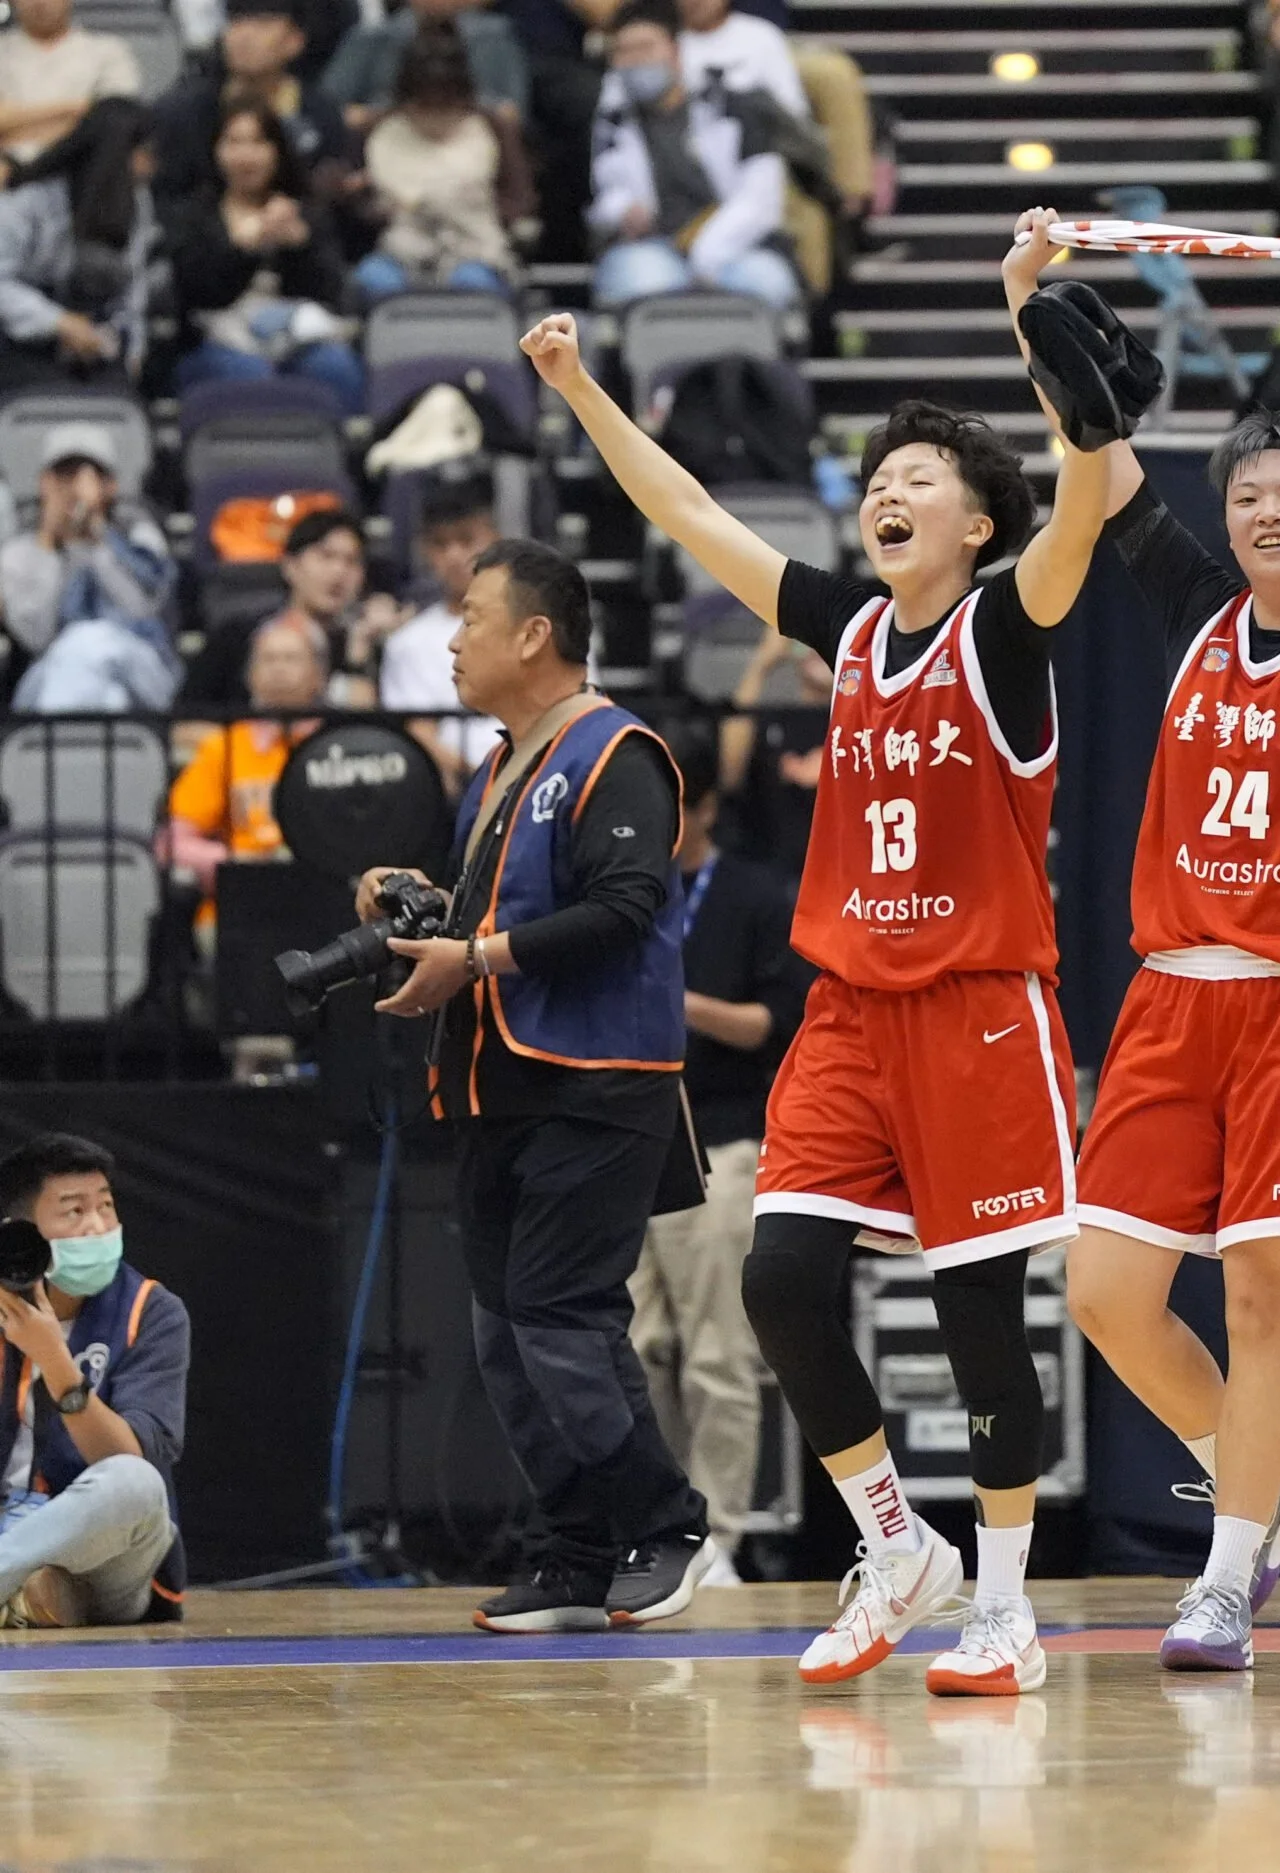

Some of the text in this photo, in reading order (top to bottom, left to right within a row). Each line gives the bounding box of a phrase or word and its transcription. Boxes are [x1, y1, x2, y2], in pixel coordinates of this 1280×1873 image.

[1200, 767, 1270, 840] 24
[864, 798, 917, 874] 13
[840, 888, 955, 921] Arastro
[1233, 889, 1256, 897] SELECT
[890, 927, 915, 935] SELECT
[971, 1186, 1047, 1219] FOOTER
[865, 1473, 908, 1540] NTNU
